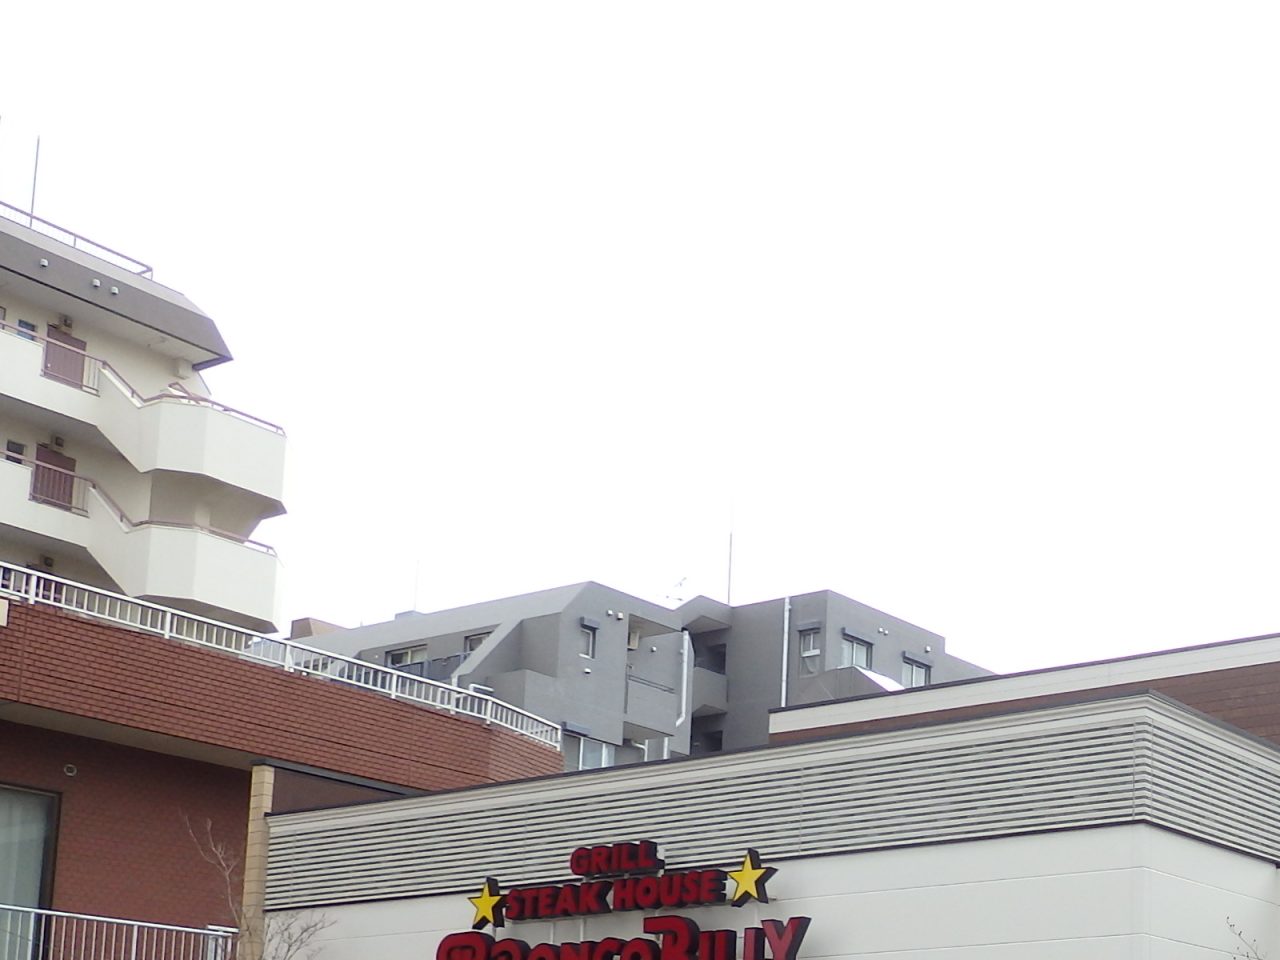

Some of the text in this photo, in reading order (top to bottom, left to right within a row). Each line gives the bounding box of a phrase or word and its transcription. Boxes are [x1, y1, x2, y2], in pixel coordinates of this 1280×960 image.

[571, 840, 664, 876] GRILL
[505, 869, 727, 920] STEAK HOUSE
